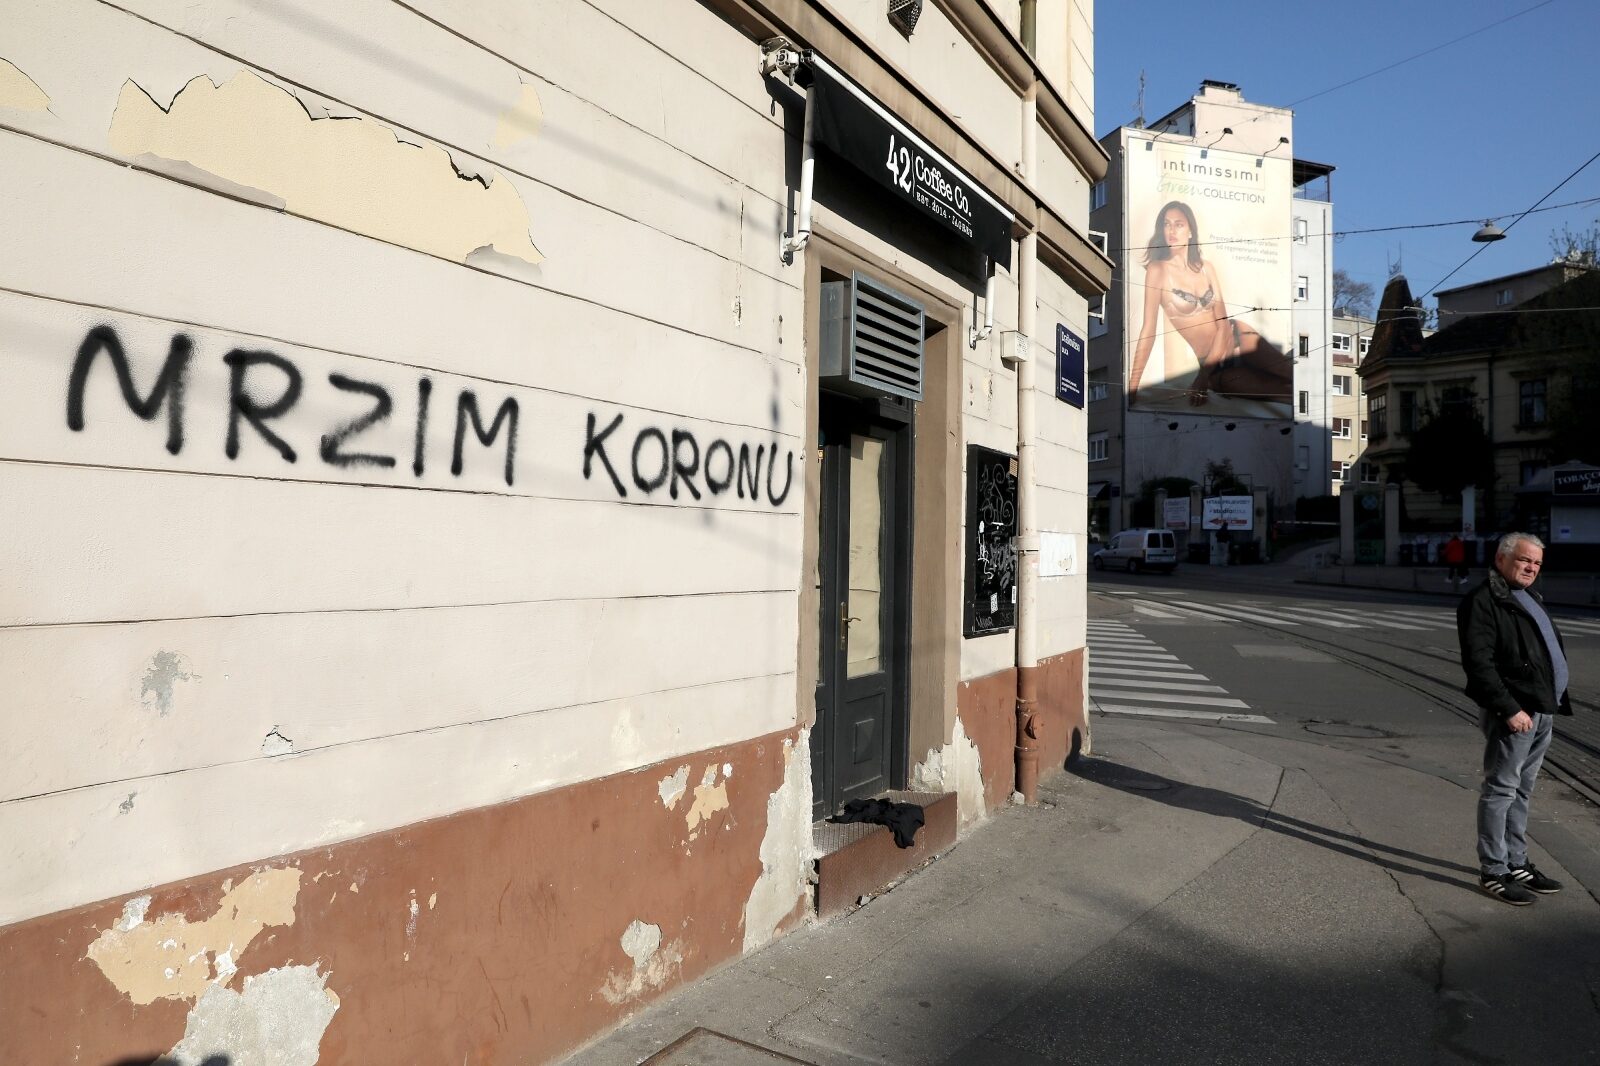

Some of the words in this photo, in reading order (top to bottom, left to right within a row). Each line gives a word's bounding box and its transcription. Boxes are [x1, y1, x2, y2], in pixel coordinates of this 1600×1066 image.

[886, 134, 912, 194] 42
[1163, 159, 1259, 182] intimissimi
[915, 155, 953, 202] Coffee
[954, 185, 972, 217] Co.
[1203, 187, 1265, 204] COLLECTION
[66, 325, 519, 487] MRZIM
[582, 412, 794, 507] KORONU
[1554, 471, 1600, 486] TOBACC
